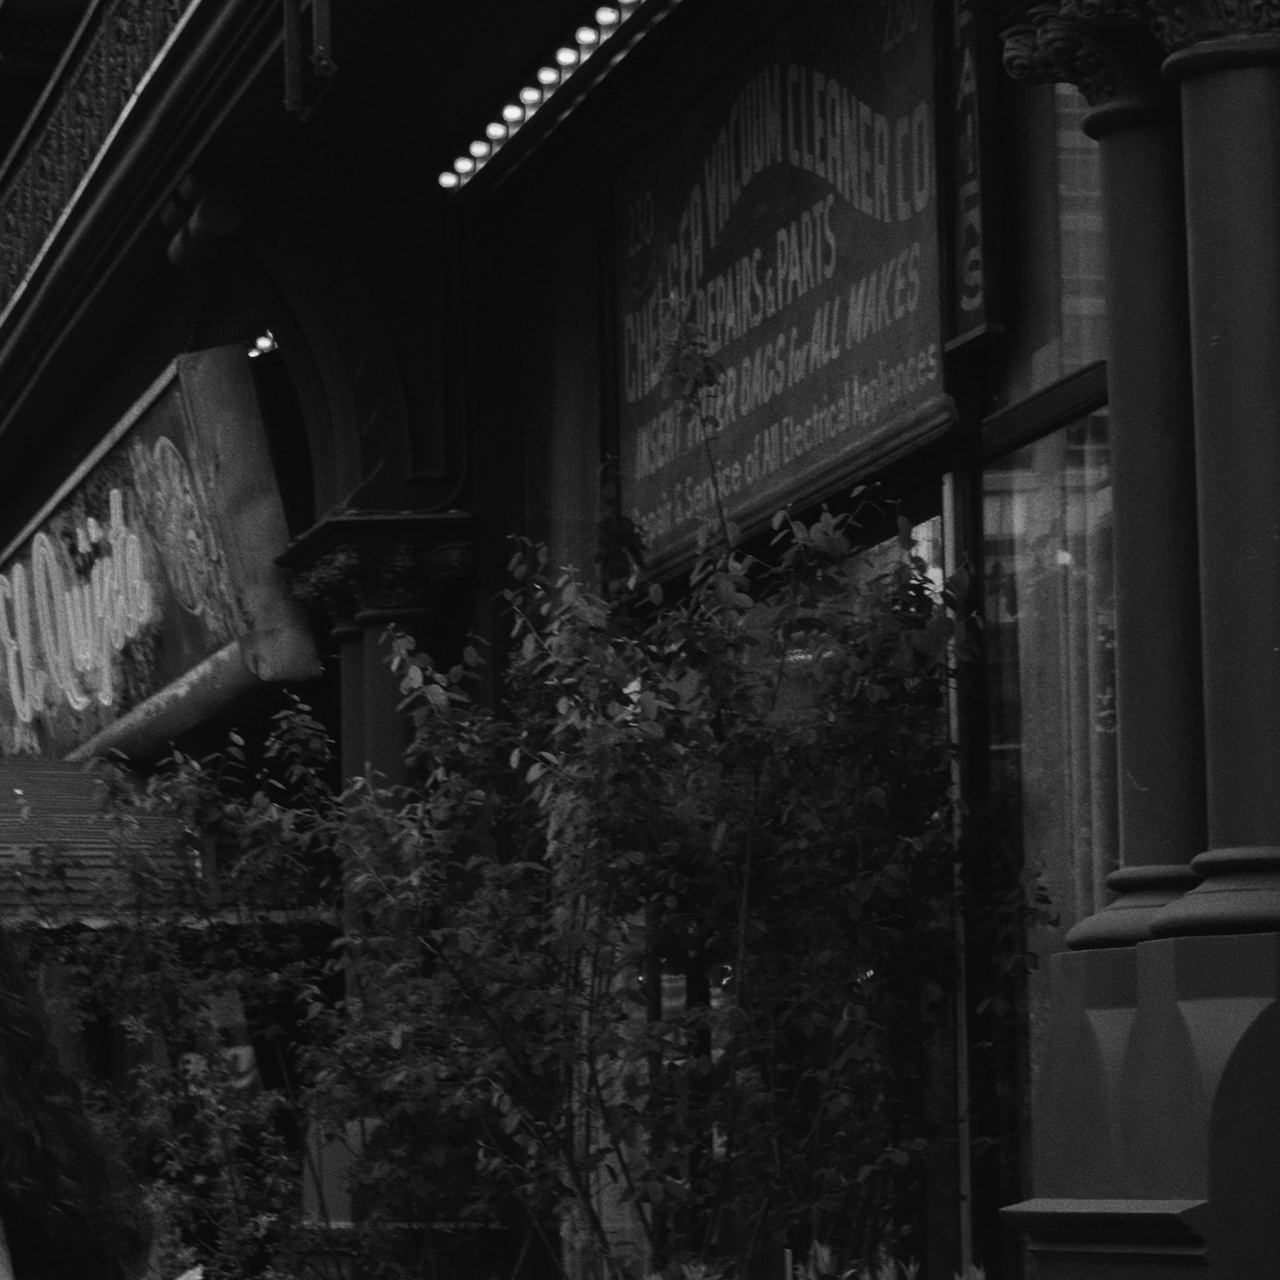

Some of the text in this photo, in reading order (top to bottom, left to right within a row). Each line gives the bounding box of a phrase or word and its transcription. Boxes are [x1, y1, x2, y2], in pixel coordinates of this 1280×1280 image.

[704, 63, 783, 249] VACUUM
[787, 63, 892, 223] CLEANER
[740, 333, 785, 416] BAGS
[808, 296, 842, 375] ALL
[845, 242, 920, 351] MAKES
[776, 193, 837, 311] PARTS
[744, 433, 761, 485] of
[781, 380, 851, 464] Electrical
[851, 343, 937, 428] Appliances
